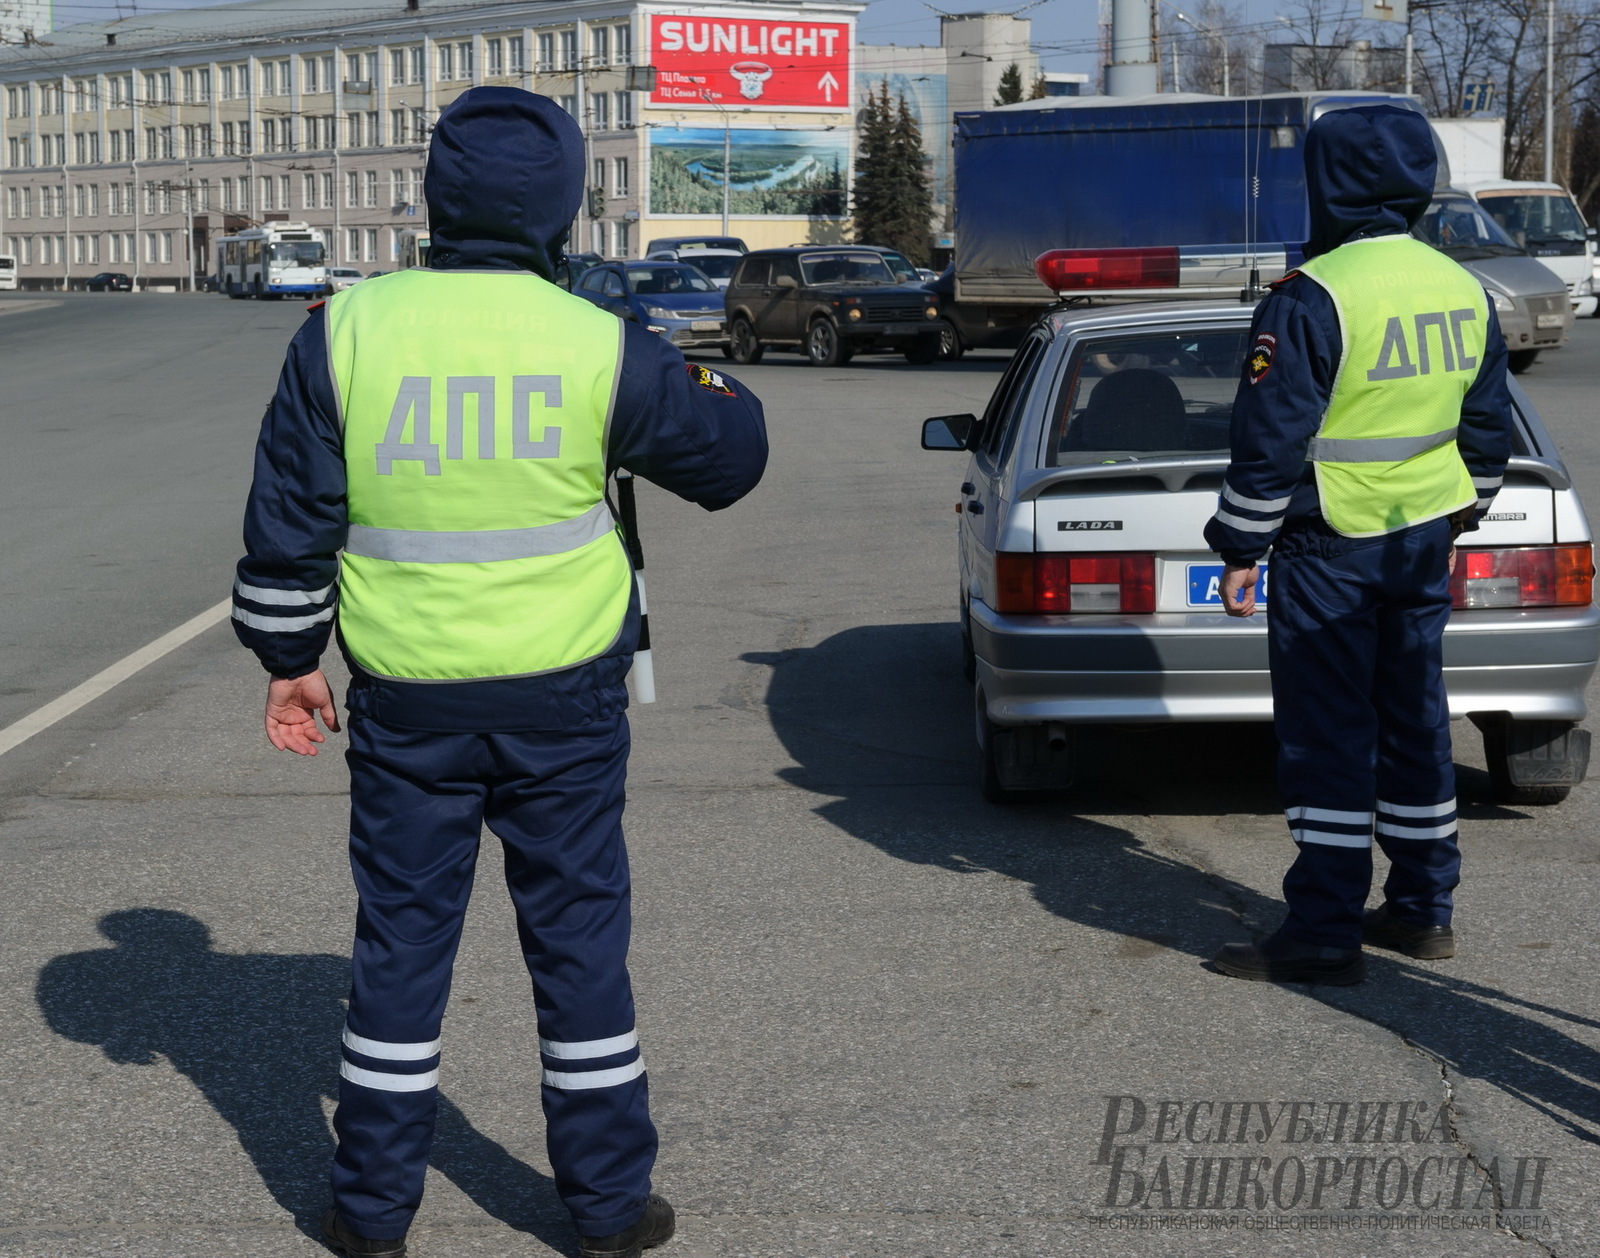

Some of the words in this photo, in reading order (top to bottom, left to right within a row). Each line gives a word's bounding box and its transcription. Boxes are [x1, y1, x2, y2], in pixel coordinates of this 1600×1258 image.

[660, 21, 839, 57] SUNLIGHT
[660, 72, 672, 83] ТЦ
[660, 87, 672, 98] ТЦ
[1367, 308, 1477, 381] ДПС
[375, 375, 562, 476] ДПС
[1481, 512, 1524, 521] mara
[1065, 521, 1115, 530] LADA
